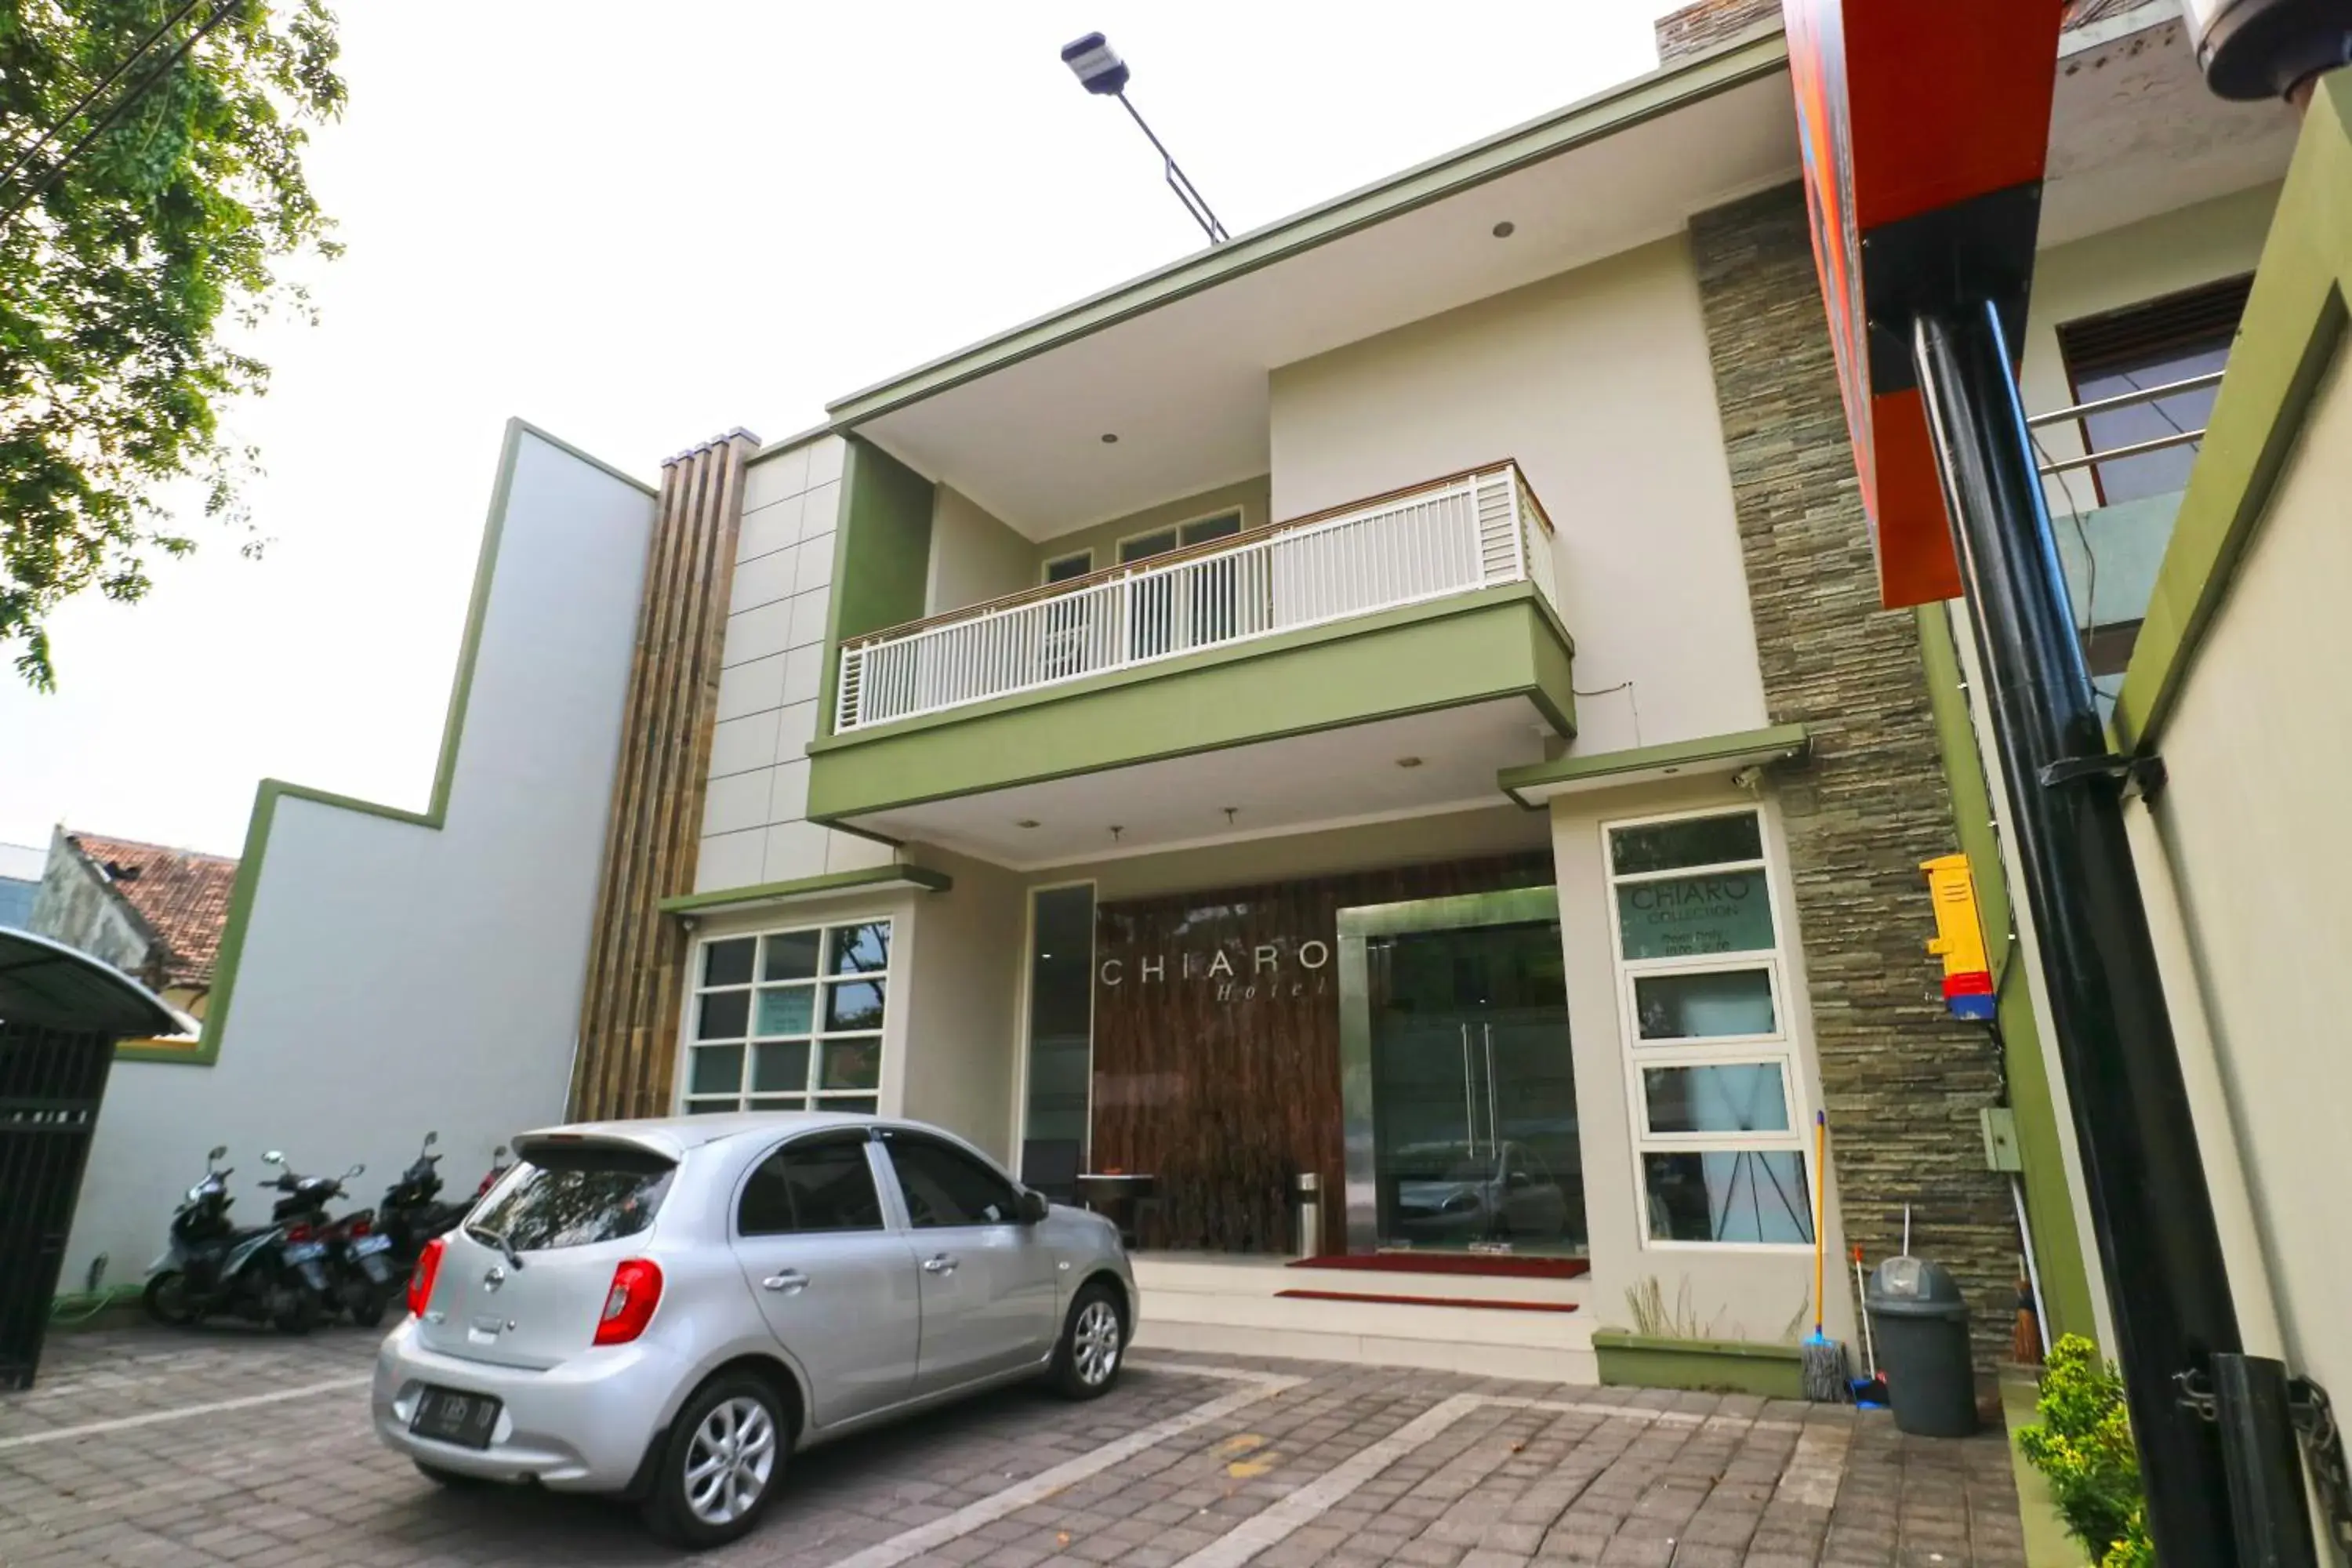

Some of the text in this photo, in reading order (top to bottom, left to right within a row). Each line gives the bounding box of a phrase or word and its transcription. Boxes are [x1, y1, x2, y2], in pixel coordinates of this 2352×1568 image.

[1632, 876, 1749, 909] CHIARO
[1648, 904, 1738, 924] COLLECTION
[1100, 940, 1329, 985] CHIARO
[1216, 976, 1327, 1002] Hotel
